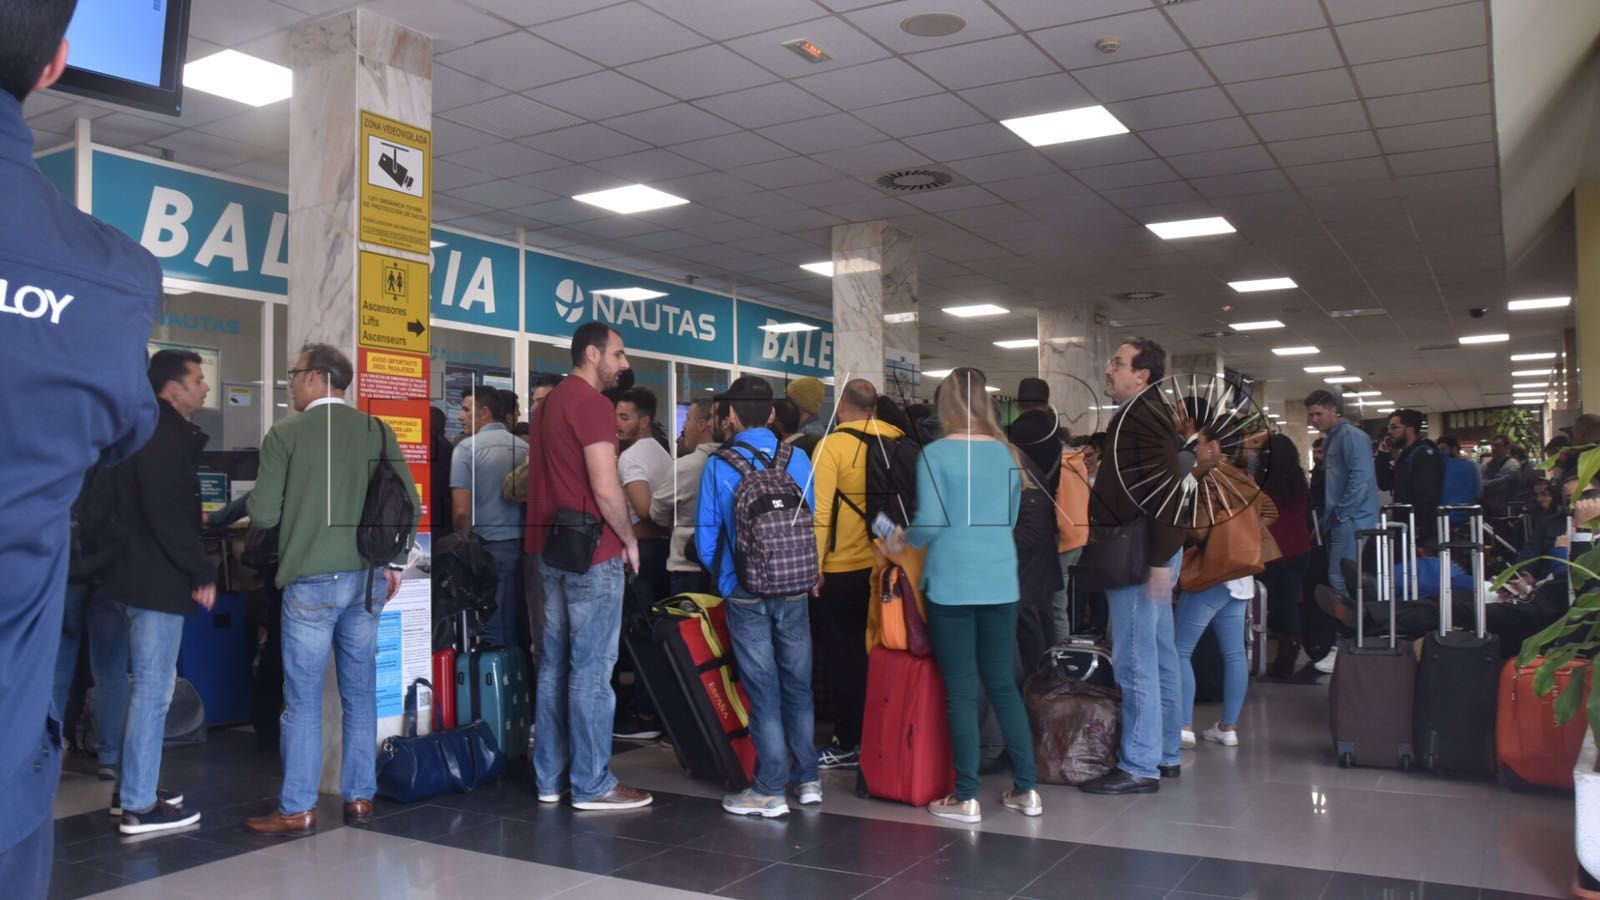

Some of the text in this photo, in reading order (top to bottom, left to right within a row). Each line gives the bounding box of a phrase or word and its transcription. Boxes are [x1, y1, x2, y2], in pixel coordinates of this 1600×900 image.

[364, 118, 428, 144] ZONA VIDEOVIGILADA
[362, 299, 407, 317] Ascensores
[592, 292, 717, 342] NAUTAS
[362, 314, 380, 328] Lifts
[362, 329, 407, 346] Ascenseurs
[761, 318, 835, 371] BALE
